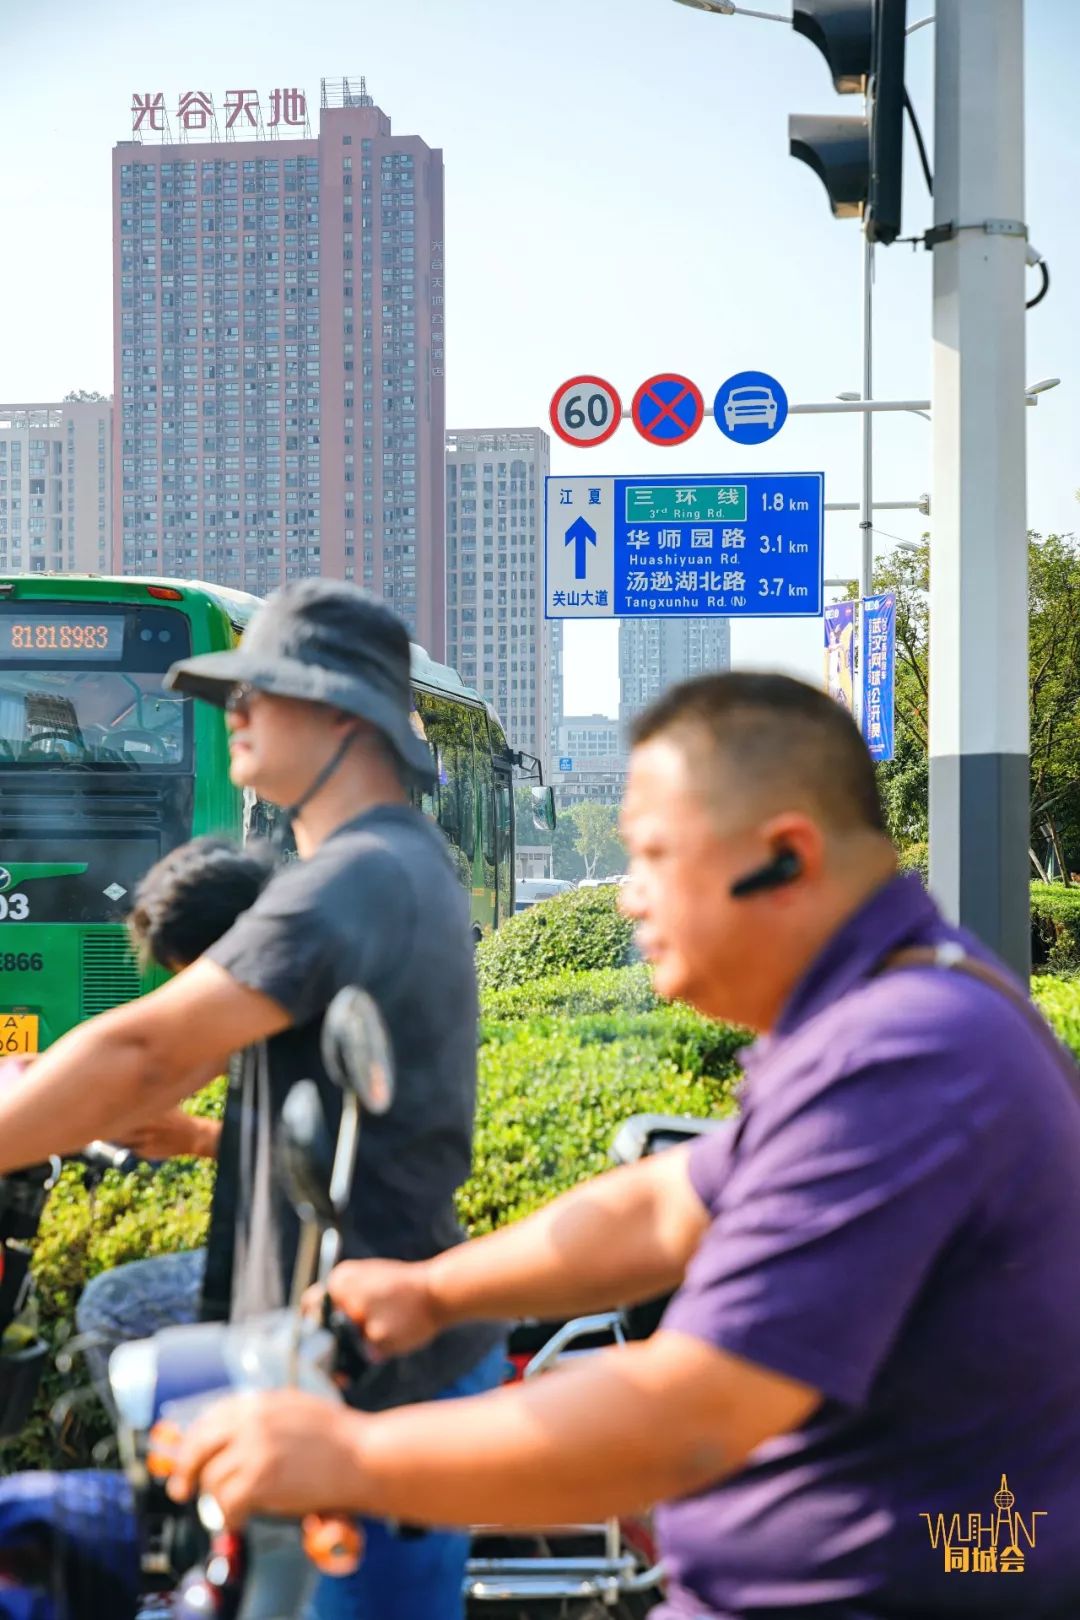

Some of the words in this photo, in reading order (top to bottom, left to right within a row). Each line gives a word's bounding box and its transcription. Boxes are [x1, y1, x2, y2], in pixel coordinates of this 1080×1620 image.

[131, 88, 306, 131] 光谷天地
[564, 394, 608, 429] 60
[560, 488, 602, 505] 江夏
[634, 488, 740, 505] 三环线
[762, 492, 784, 511] 1.8
[789, 498, 809, 511] km
[649, 508, 668, 518] 3rd
[674, 509, 701, 520] Ring
[707, 508, 725, 518] Rd.
[626, 528, 746, 550] 华师园路
[760, 535, 782, 554] 3.1
[789, 540, 808, 553] km
[629, 554, 712, 567] Huashiyuan
[626, 571, 746, 592] 汤逊湖北路
[758, 578, 784, 597] 3.7
[788, 583, 808, 597] km
[552, 590, 609, 607] 关山大道
[625, 596, 699, 610] Tangxunhu
[11, 625, 108, 648] 81818983
[0, 953, 43, 971] 866
